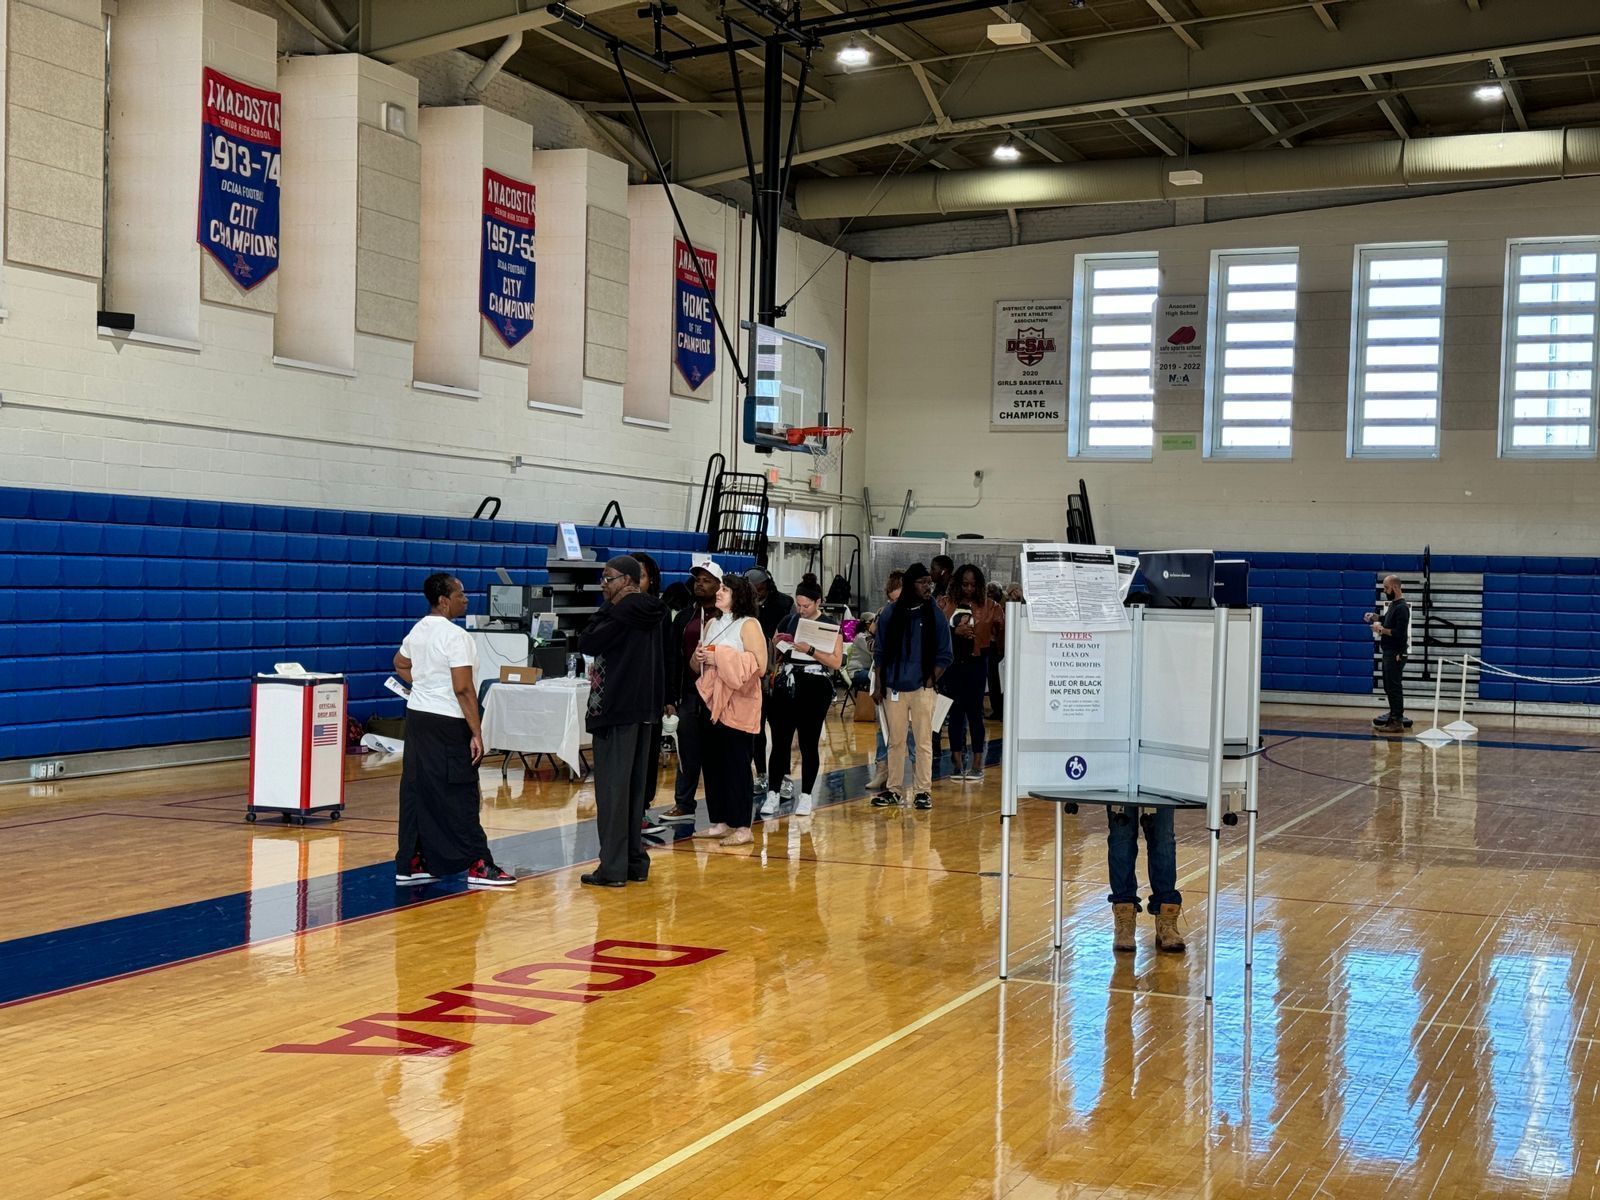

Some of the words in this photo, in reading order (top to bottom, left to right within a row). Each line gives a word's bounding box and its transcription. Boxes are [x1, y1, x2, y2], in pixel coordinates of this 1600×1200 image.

[207, 79, 281, 131] ANACOSTIA
[250, 127, 271, 141] SCHOOL
[209, 132, 281, 188] 1973-74
[221, 179, 243, 196] DCIAA
[229, 202, 258, 230] CITY
[210, 219, 277, 258] CHAMPIONS
[502, 276, 522, 298] CITY
[489, 292, 535, 321] CHAMPIONS
[682, 291, 712, 323] HOME
[688, 322, 694, 333] OF
[694, 324, 703, 335] THE
[677, 331, 711, 355] CHAMPION
[1005, 337, 1056, 353] DCSAA
[1159, 363, 1177, 371] 2019
[1013, 400, 1046, 408] STATE
[999, 411, 1059, 419] CHAMPIONS
[1060, 631, 1093, 640] VOTERS
[1048, 679, 1067, 687] BLUE
[1067, 679, 1079, 687] OR
[1079, 679, 1103, 687] BLACK
[260, 939, 729, 1057] DCIAA
